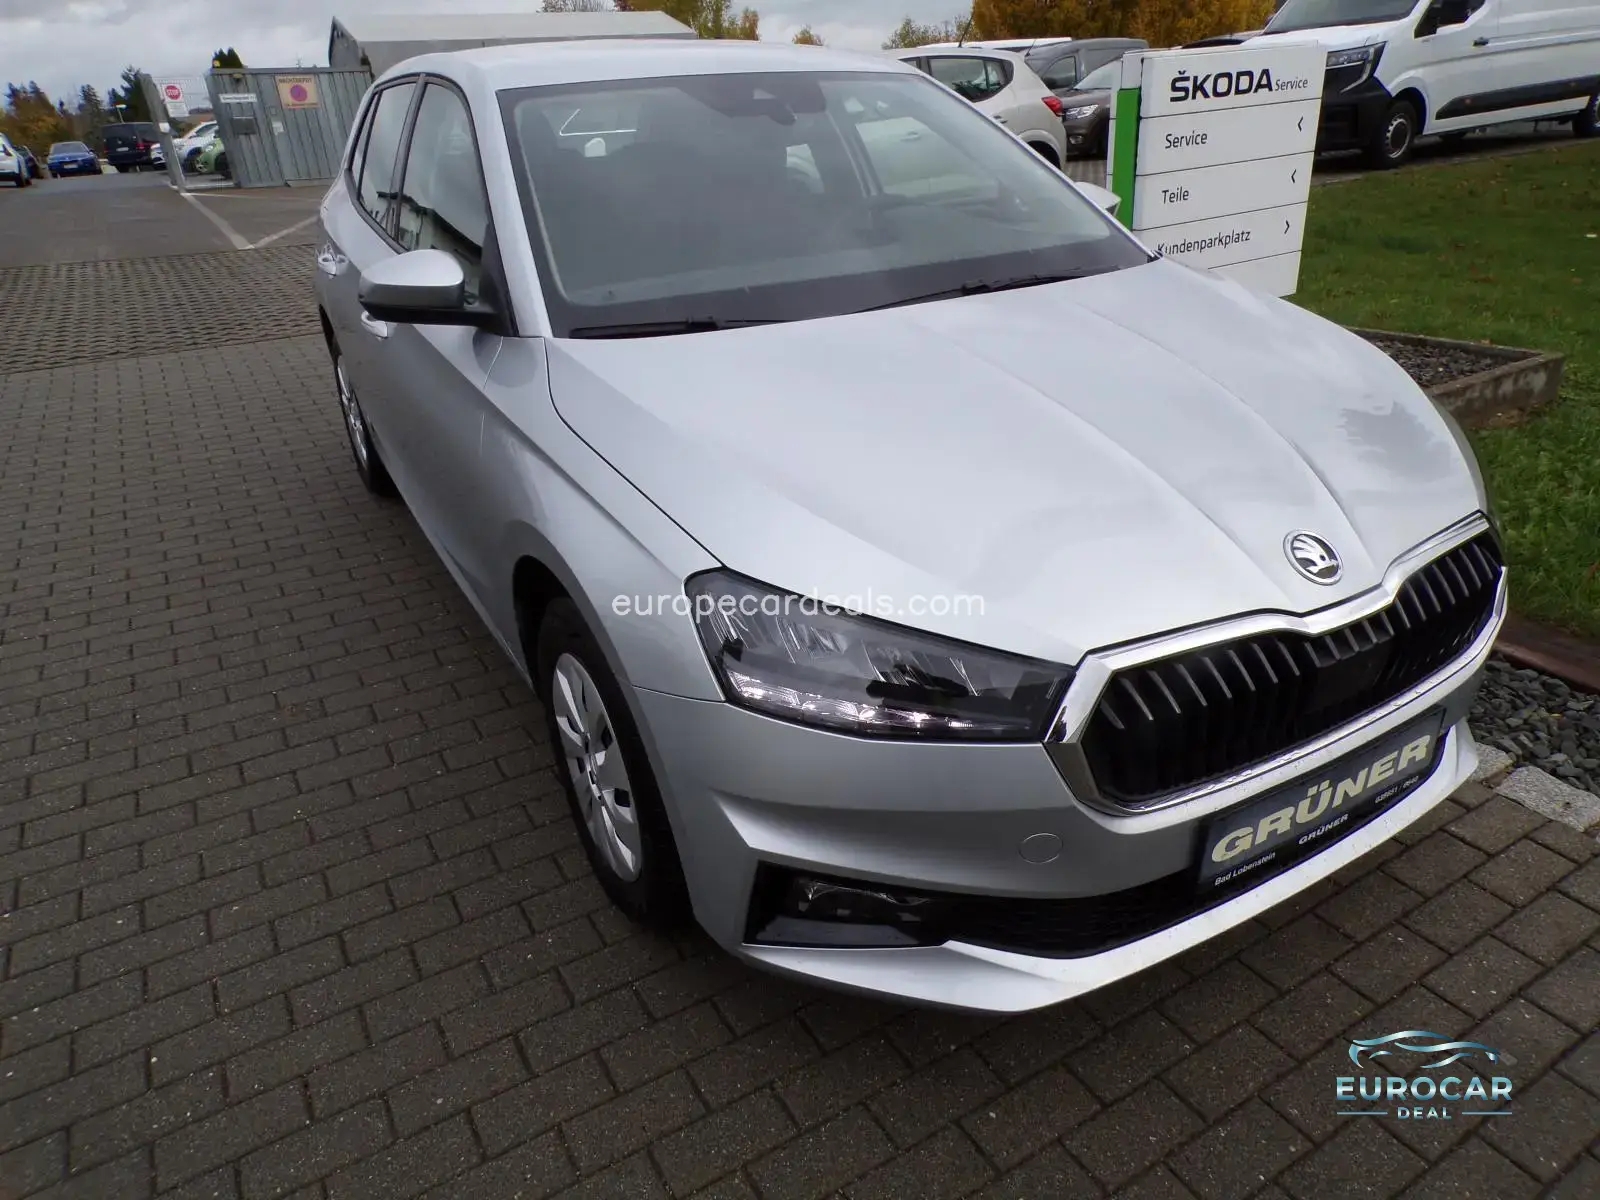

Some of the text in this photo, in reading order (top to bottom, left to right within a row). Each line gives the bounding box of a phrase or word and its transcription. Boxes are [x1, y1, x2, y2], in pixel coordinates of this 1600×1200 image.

[166, 89, 179, 97] STOP
[1170, 69, 1308, 102] ŠKODA Service
[1165, 131, 1208, 149] Service
[1162, 187, 1189, 204] Teile
[1157, 230, 1251, 255] Kundenparkplatz
[1211, 734, 1431, 863] GRÜNER
[1298, 813, 1349, 845] GRÜNER
[1214, 871, 1231, 886] Bad
